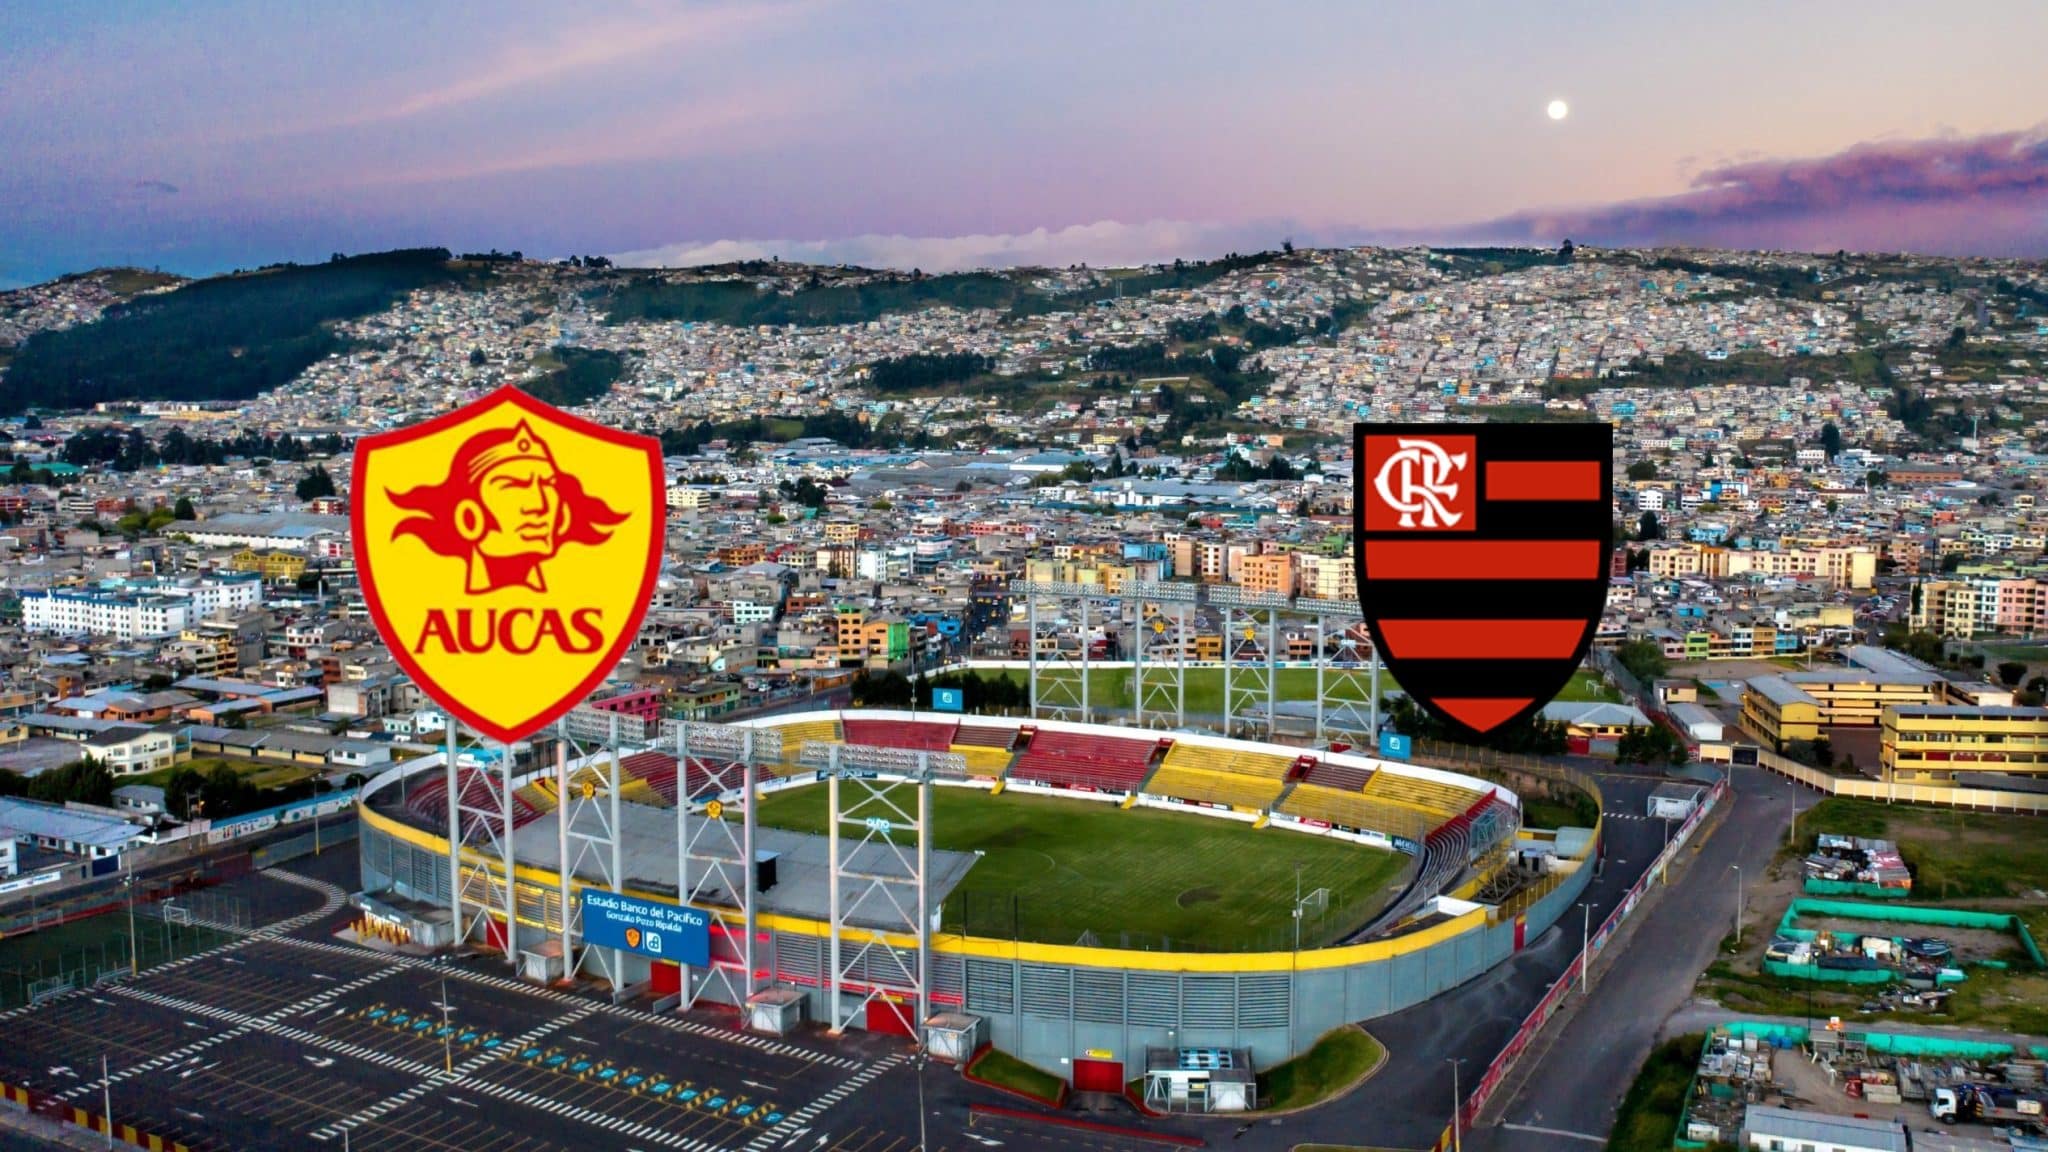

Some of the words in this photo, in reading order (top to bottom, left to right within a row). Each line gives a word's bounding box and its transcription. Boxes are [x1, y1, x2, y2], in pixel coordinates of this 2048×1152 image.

[587, 894, 619, 910] Estadio
[621, 901, 648, 915] Banco
[650, 906, 664, 918] del
[606, 910, 635, 923] Gonzalo
[635, 917, 654, 926] Pozo
[655, 919, 682, 933] Ripalda
